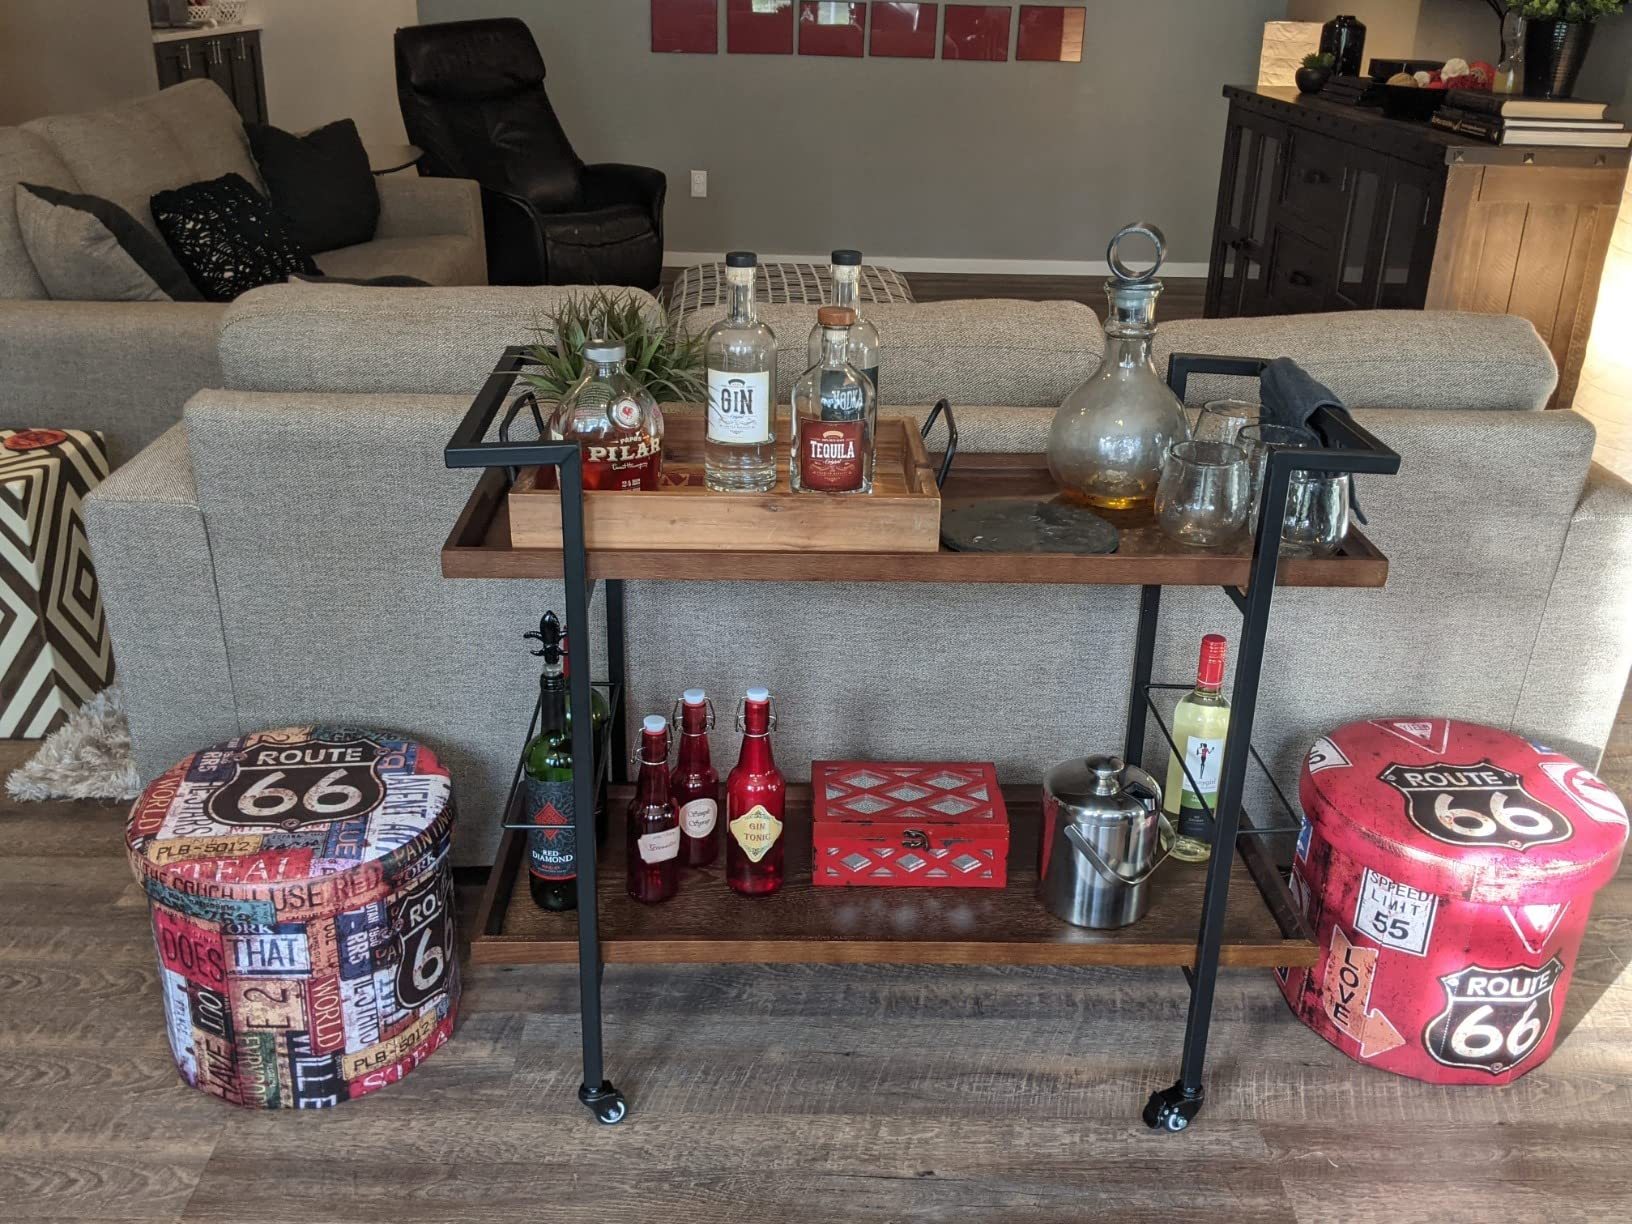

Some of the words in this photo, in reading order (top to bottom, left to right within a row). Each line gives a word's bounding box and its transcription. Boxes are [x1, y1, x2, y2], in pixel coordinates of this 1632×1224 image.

[721, 388, 753, 414] GIN
[588, 438, 660, 462] PILAR
[810, 440, 855, 458] TEQUILA
[257, 748, 363, 764] ROUTE
[237, 768, 362, 816] 66
[1407, 770, 1504, 788] ROUTE
[138, 776, 181, 830] WORLD
[1433, 791, 1553, 837] 66
[744, 832, 771, 841] TONIC
[749, 823, 766, 831] GIN
[532, 850, 573, 864] DIAMOND
[268, 882, 323, 911] USE
[227, 923, 274, 935] ORK
[1372, 910, 1411, 940] 55
[161, 927, 224, 984] DOES
[229, 938, 298, 967] THAT
[1334, 948, 1359, 1025] LOVE
[1466, 970, 1550, 997] ROUTE
[312, 979, 342, 1047] WORLD
[1450, 1000, 1541, 1057] 66
[205, 1039, 242, 1107] HAVE
